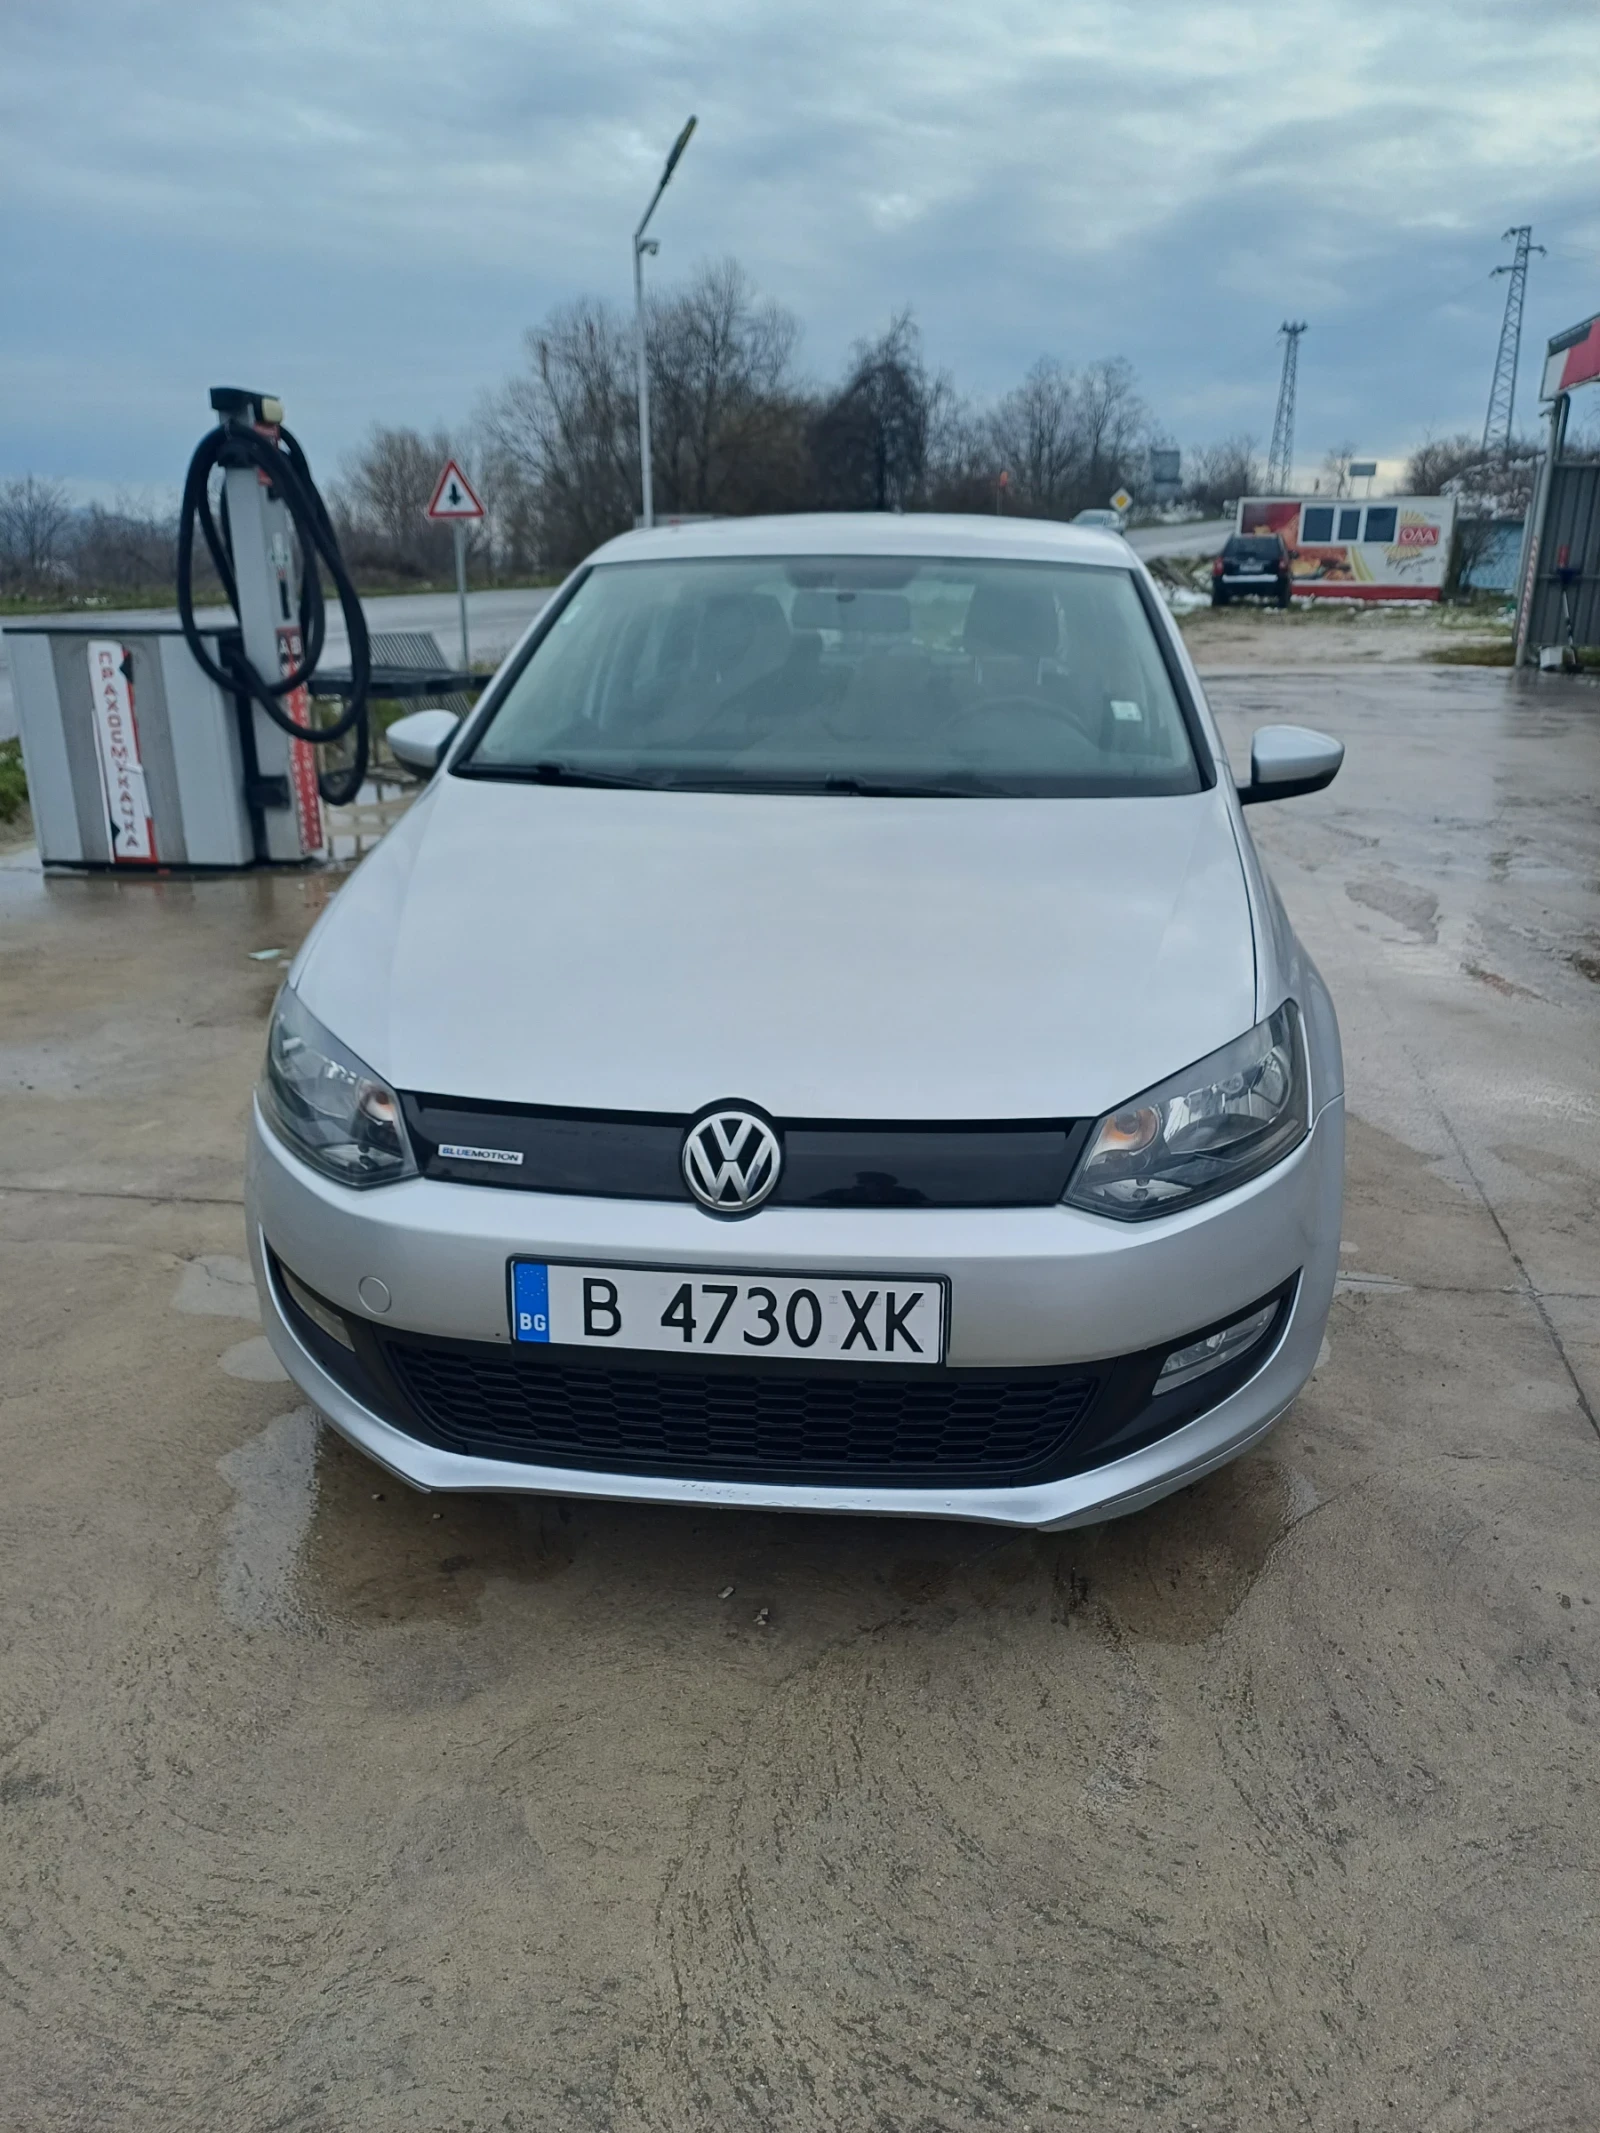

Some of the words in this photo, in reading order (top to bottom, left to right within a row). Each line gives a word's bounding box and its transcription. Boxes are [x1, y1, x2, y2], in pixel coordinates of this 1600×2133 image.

[442, 1146, 519, 1162] BLUEMOTION
[682, 1111, 780, 1212] VW
[519, 1312, 547, 1332] BG
[582, 1277, 622, 1337] B
[660, 1283, 823, 1349] 4730
[839, 1289, 925, 1353] XK
